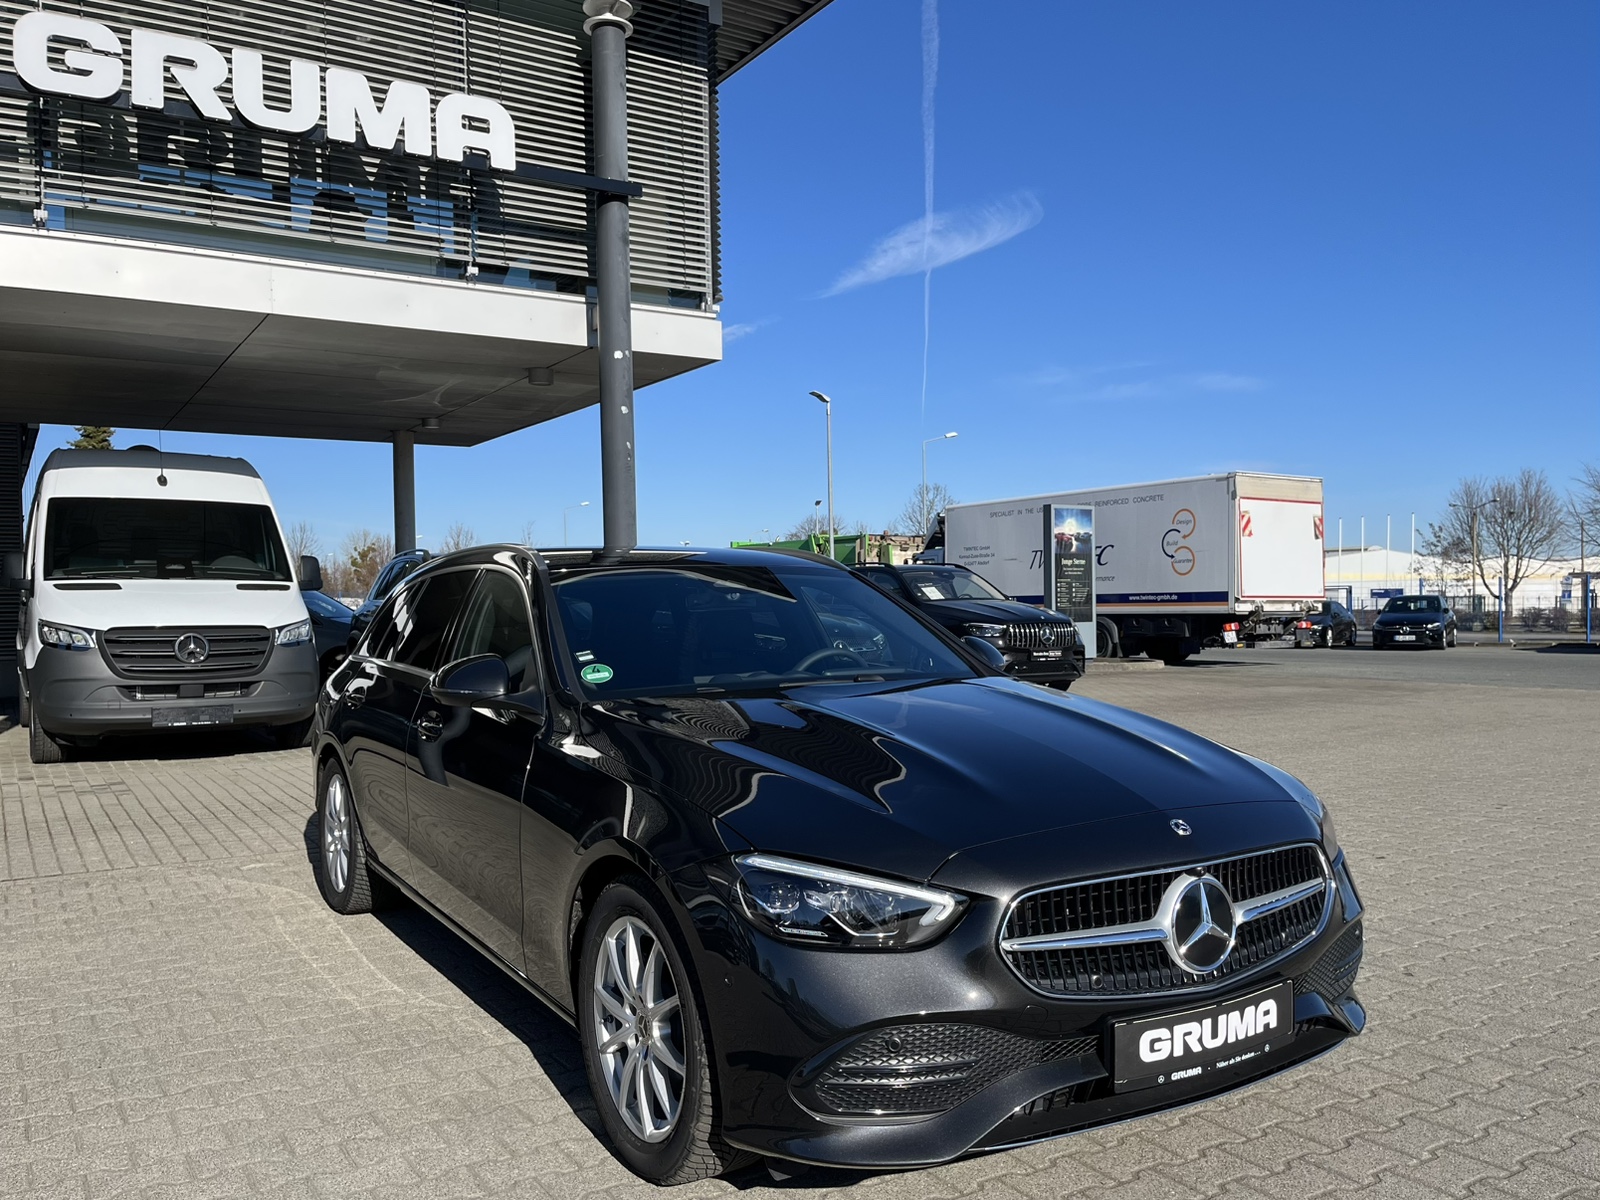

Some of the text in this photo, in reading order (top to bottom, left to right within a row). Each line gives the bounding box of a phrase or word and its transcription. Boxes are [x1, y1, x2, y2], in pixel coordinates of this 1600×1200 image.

[12, 10, 517, 172] GRUMA
[989, 509, 1015, 519] SPECIALIST
[1025, 507, 1034, 515] THE
[1094, 497, 1129, 507] REINFORCED
[1132, 493, 1165, 504] CONCRETE
[1128, 593, 1178, 602] www.twintec-gmbh.de
[592, 665, 601, 673] 4
[1139, 998, 1278, 1063] GRUMA
[1171, 1066, 1202, 1081] GRUMA
